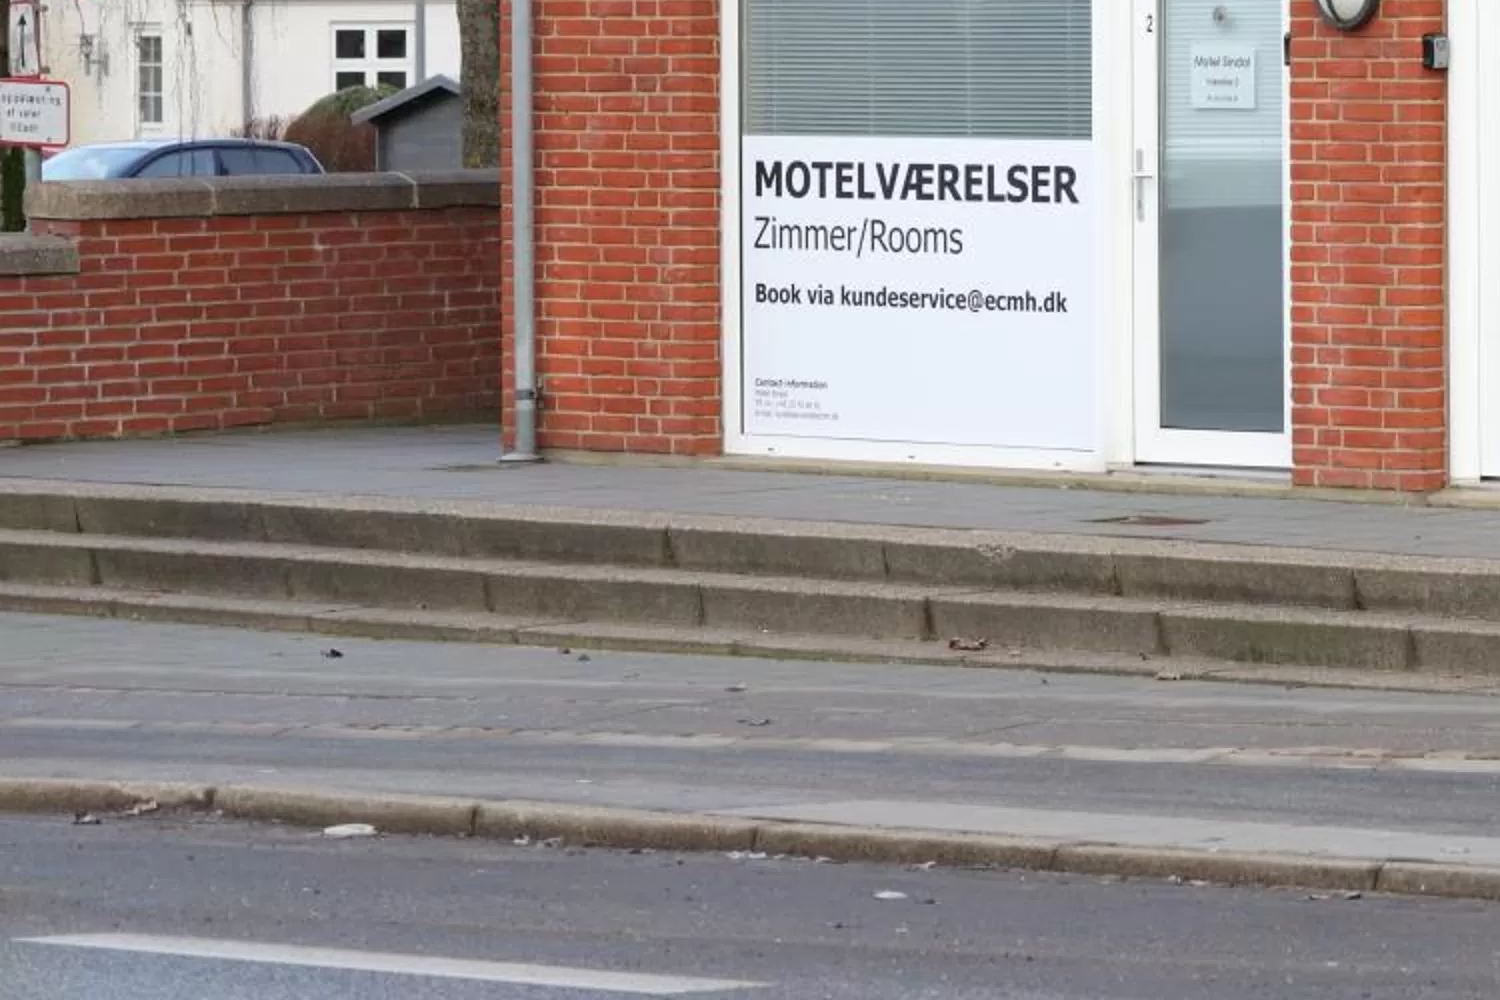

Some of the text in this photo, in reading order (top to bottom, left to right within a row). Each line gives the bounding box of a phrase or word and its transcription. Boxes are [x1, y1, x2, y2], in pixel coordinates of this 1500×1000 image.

[1146, 14, 1153, 33] 2
[755, 160, 1080, 205] MOTELVÆRELSER
[754, 216, 963, 258] Zimmer/Rooms
[755, 283, 1068, 313] Book via kundeservice@ecmh.dk
